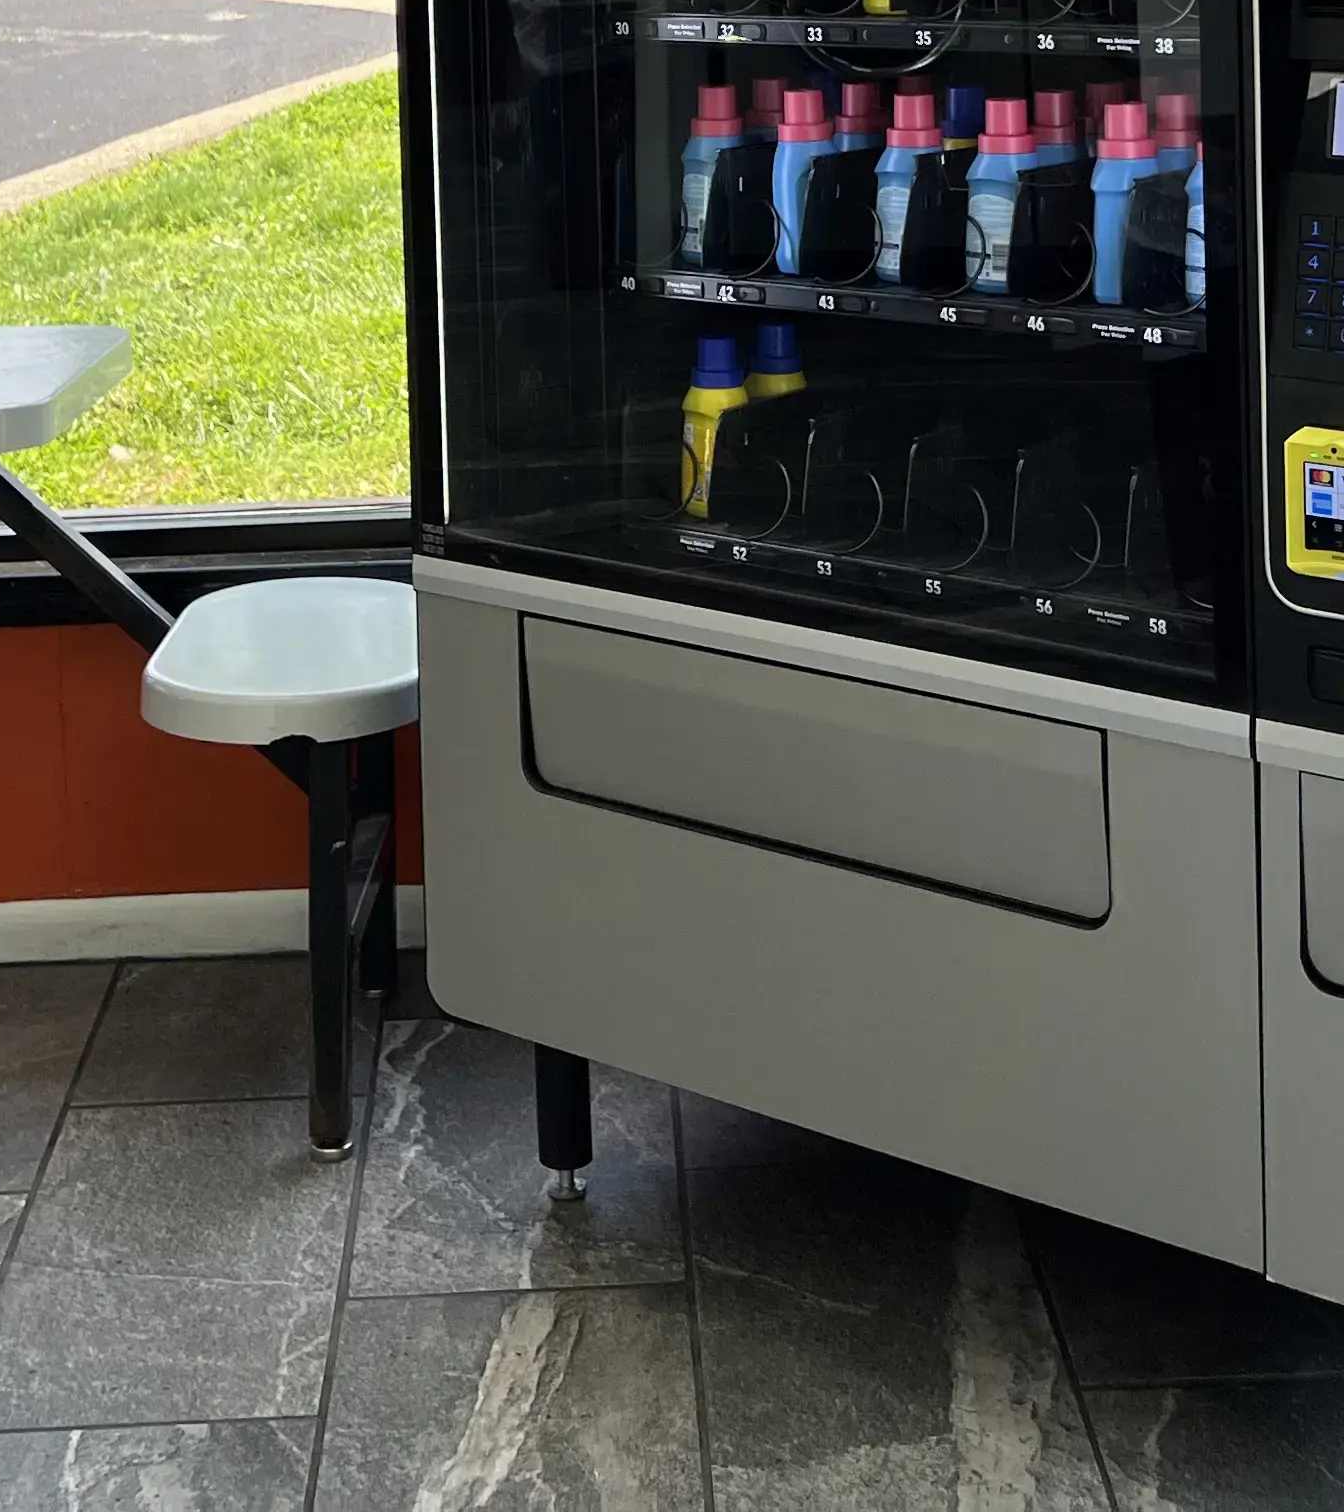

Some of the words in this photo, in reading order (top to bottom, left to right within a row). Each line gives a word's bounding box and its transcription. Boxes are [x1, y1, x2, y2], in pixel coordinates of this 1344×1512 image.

[615, 21, 630, 35] 30
[807, 26, 823, 42] 33
[915, 30, 932, 46] 35
[1037, 33, 1055, 50] 36
[1154, 37, 1174, 54] 38
[1311, 221, 1320, 236] 1
[1308, 255, 1319, 270] 4
[621, 276, 636, 291] 40
[818, 295, 835, 310] 43
[1307, 289, 1317, 304] 7
[939, 306, 957, 323] 45
[1027, 315, 1045, 332] 46
[1143, 327, 1163, 344] 48
[732, 546, 747, 561] 52
[816, 560, 832, 576] 53
[925, 578, 942, 595] 55
[1036, 598, 1053, 615] 56
[1149, 617, 1167, 635] 58
